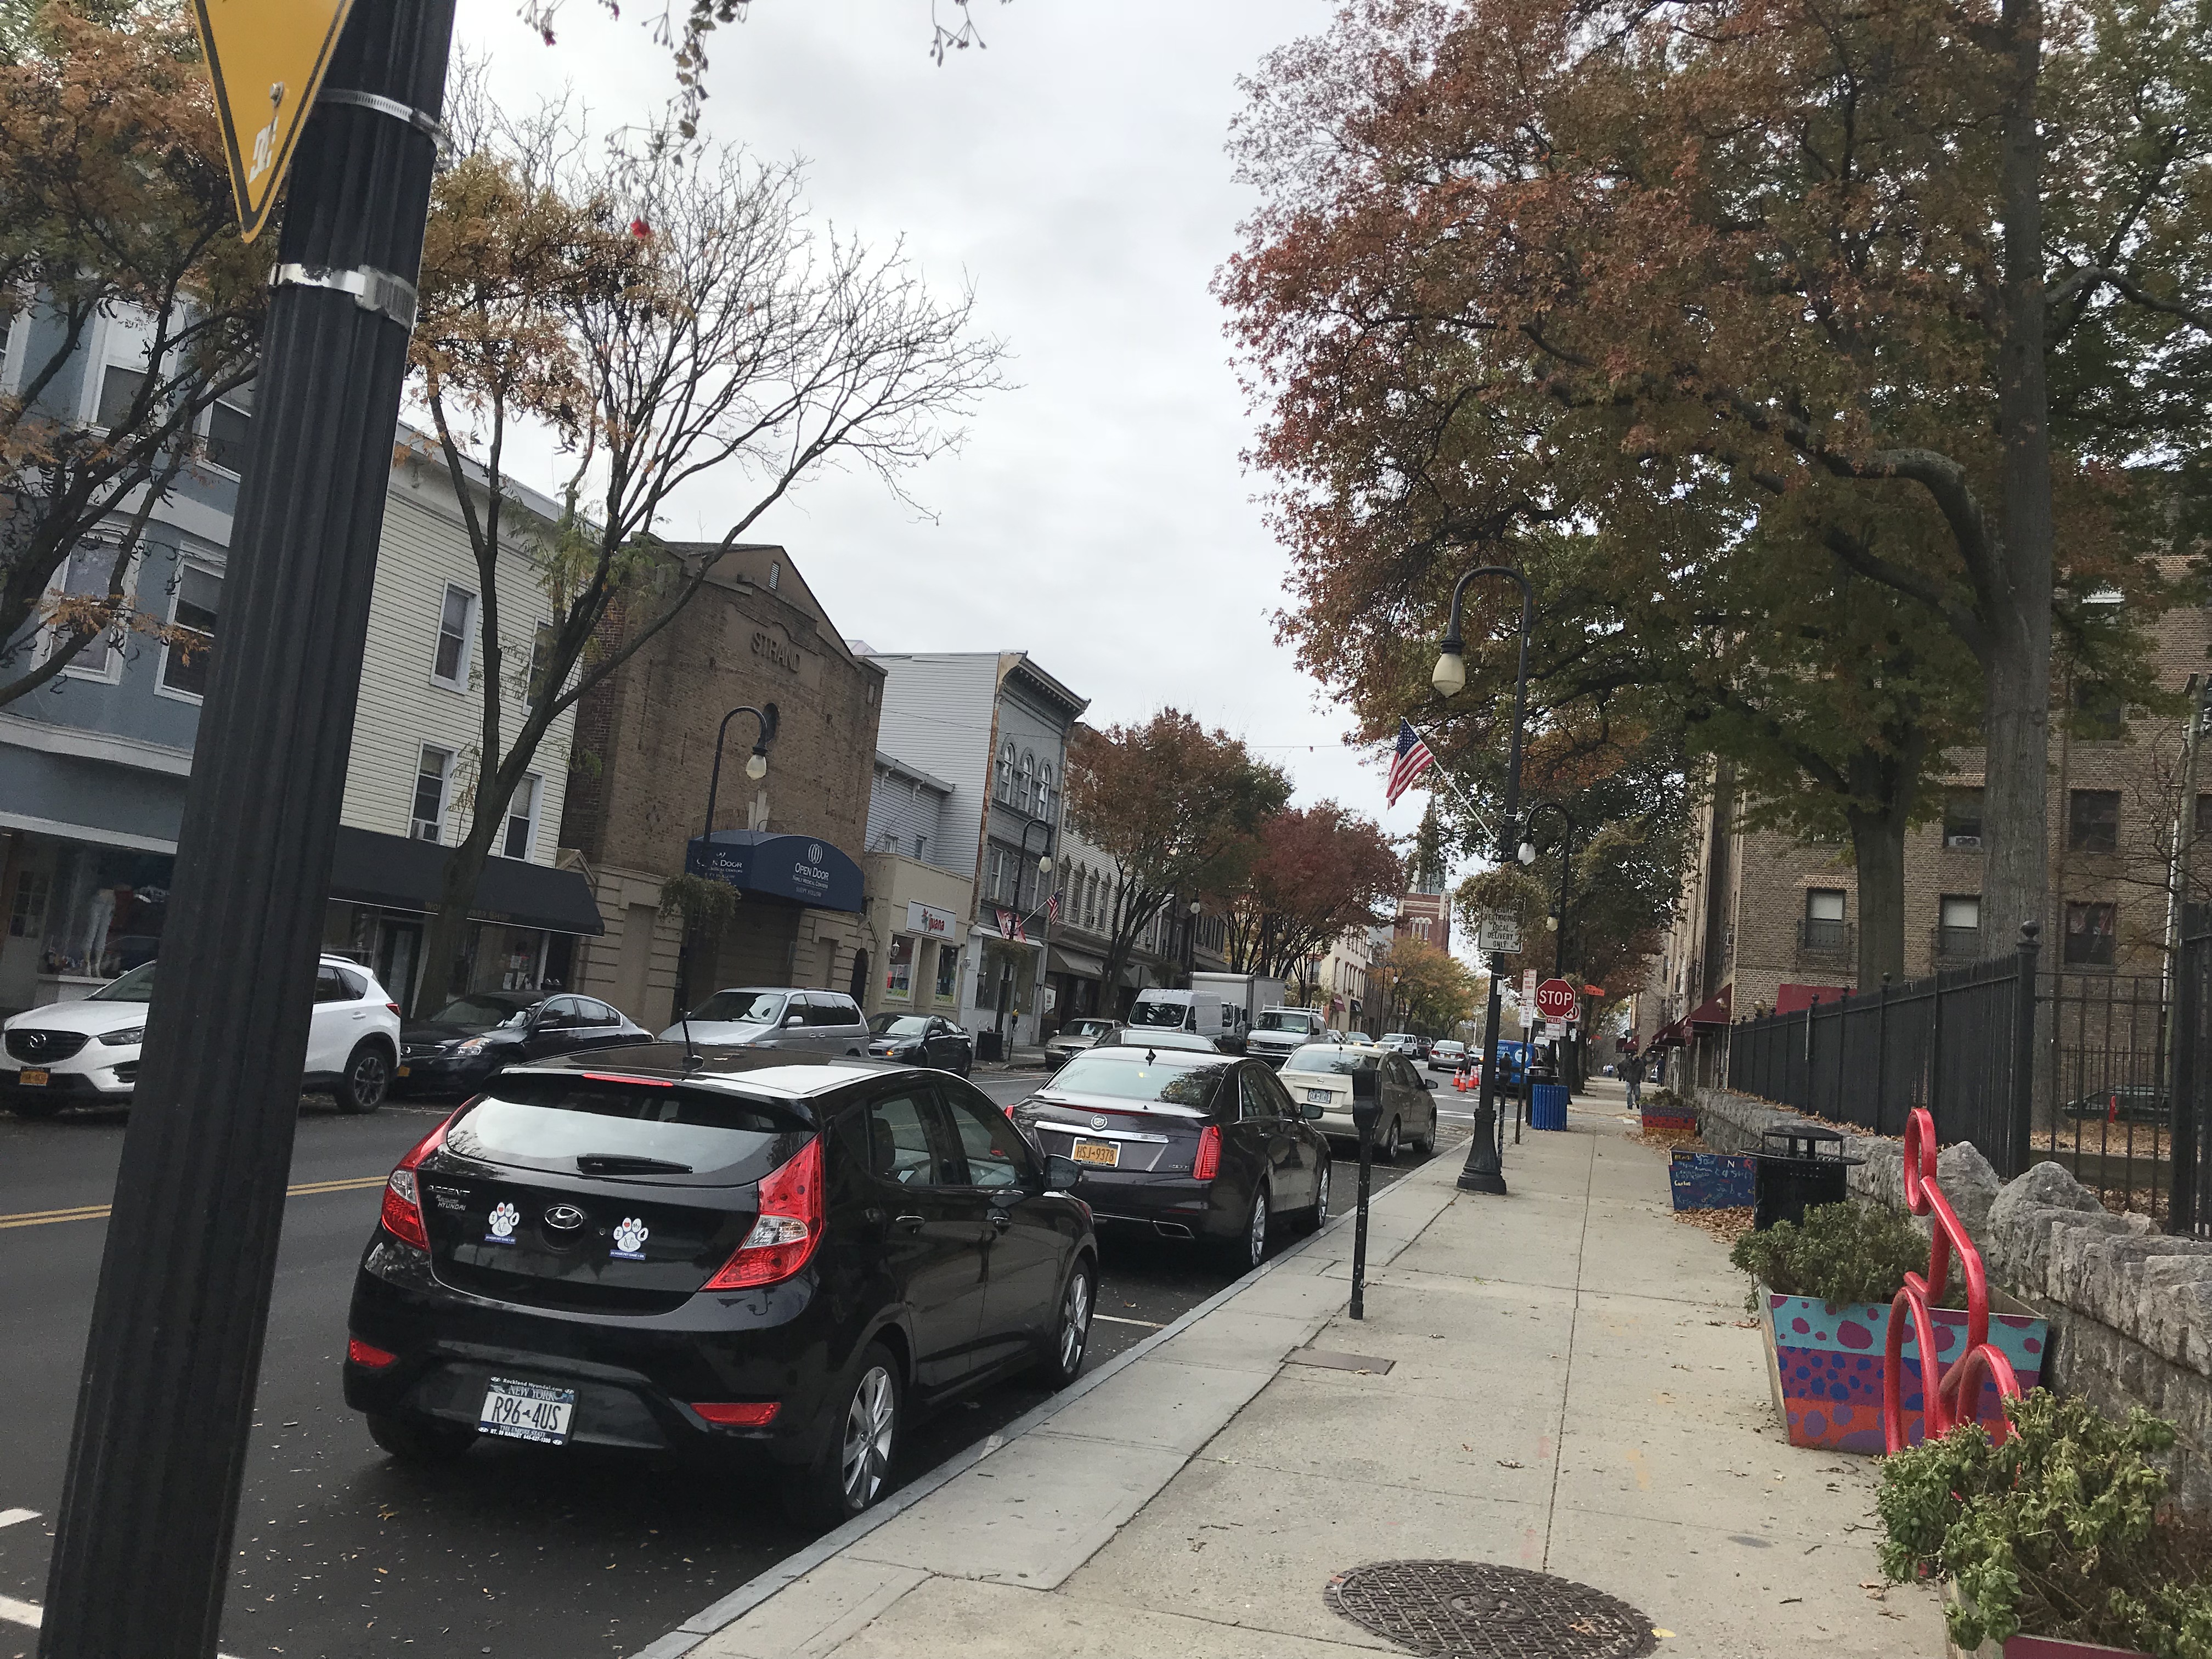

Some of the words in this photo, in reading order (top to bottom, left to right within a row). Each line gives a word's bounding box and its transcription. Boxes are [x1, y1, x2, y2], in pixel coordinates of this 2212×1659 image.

[751, 633, 800, 673] STRAND
[720, 860, 742, 868] DOOR
[795, 862, 812, 876] OPEN
[812, 867, 829, 881] DOOR
[1492, 924, 1509, 932] LOCAL
[1487, 932, 1513, 940] DELIVERY
[1493, 940, 1507, 949] ONLY
[1539, 990, 1572, 1006] STOP
[1727, 1160, 1735, 1168] N
[426, 1185, 470, 1197] ACCENT
[438, 1202, 466, 1211] HYUNDAI
[503, 1378, 527, 1386] Rockland
[528, 1383, 563, 1392] Hyundai.com
[508, 1385, 530, 1397] NEW
[531, 1387, 555, 1401] YORK
